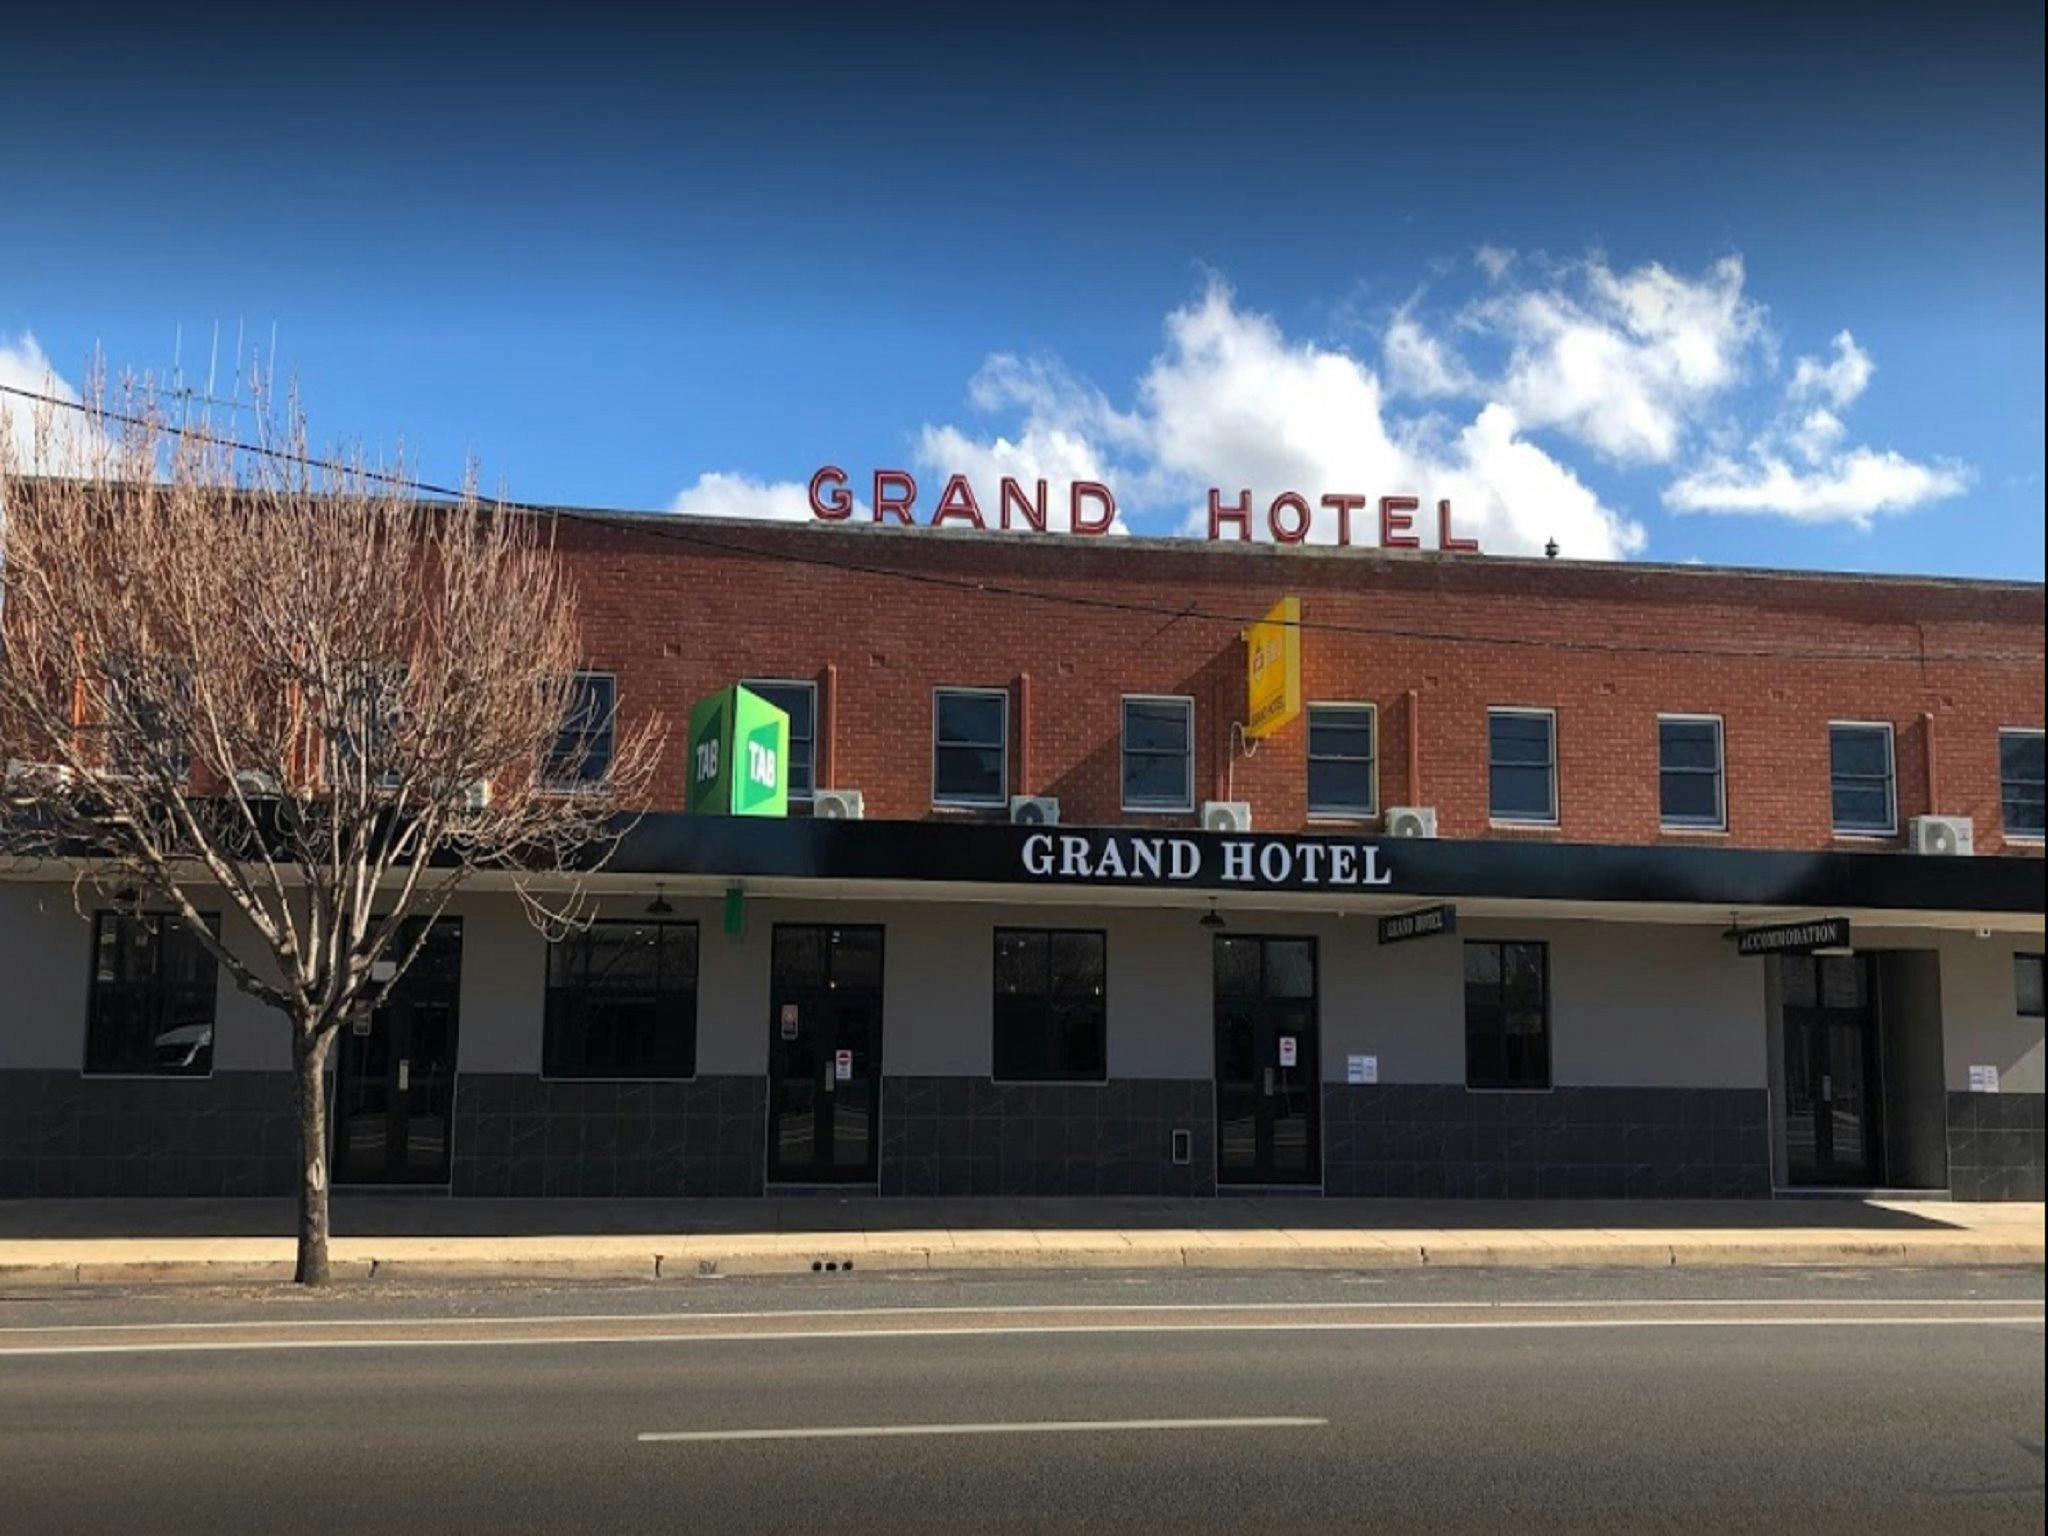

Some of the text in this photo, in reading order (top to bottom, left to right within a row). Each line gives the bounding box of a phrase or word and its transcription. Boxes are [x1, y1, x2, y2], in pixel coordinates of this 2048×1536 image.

[808, 465, 1479, 551] GRAND HOTEL
[697, 738, 719, 782] TAB
[749, 740, 776, 789] TAB
[1021, 834, 1392, 884] GRAND HOTEL
[1741, 923, 1836, 951] ACCOMMODATION
